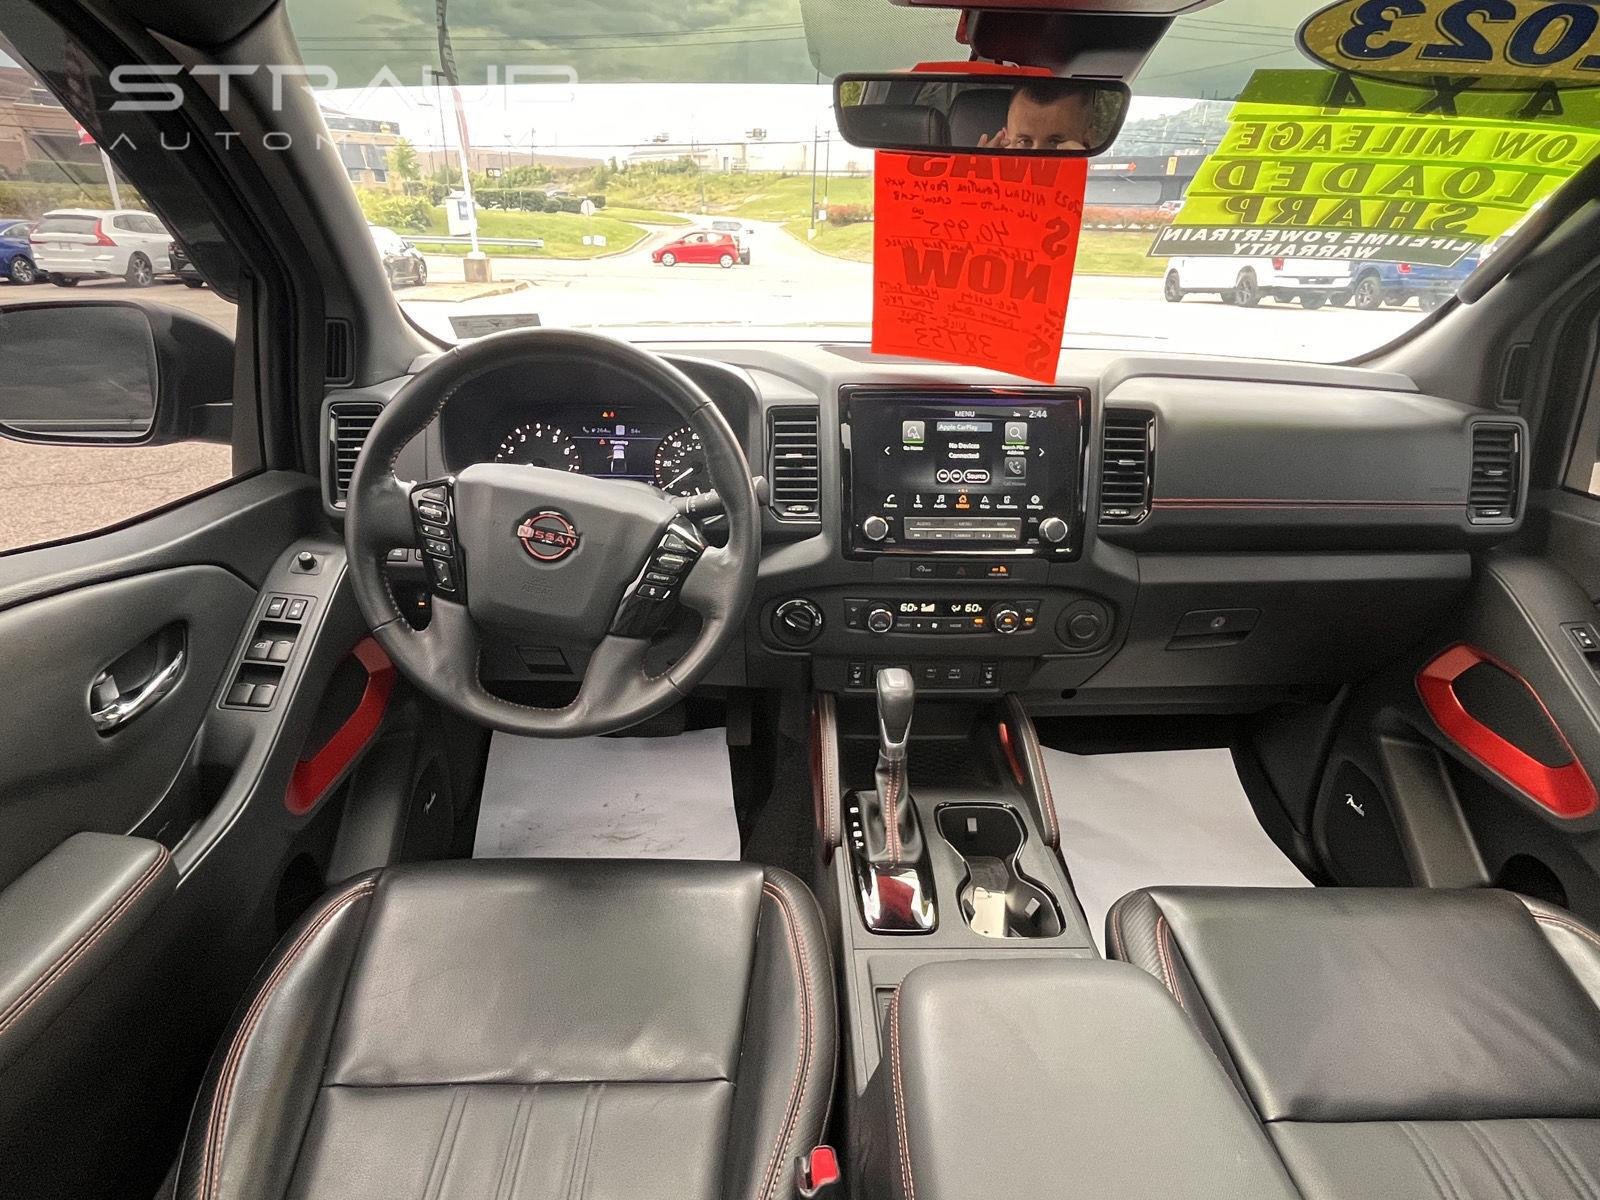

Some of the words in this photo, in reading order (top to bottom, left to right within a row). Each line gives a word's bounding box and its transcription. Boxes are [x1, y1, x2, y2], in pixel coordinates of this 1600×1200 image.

[955, 410, 976, 418] MENU
[1028, 410, 1048, 419] 2:44
[966, 472, 987, 480] Source
